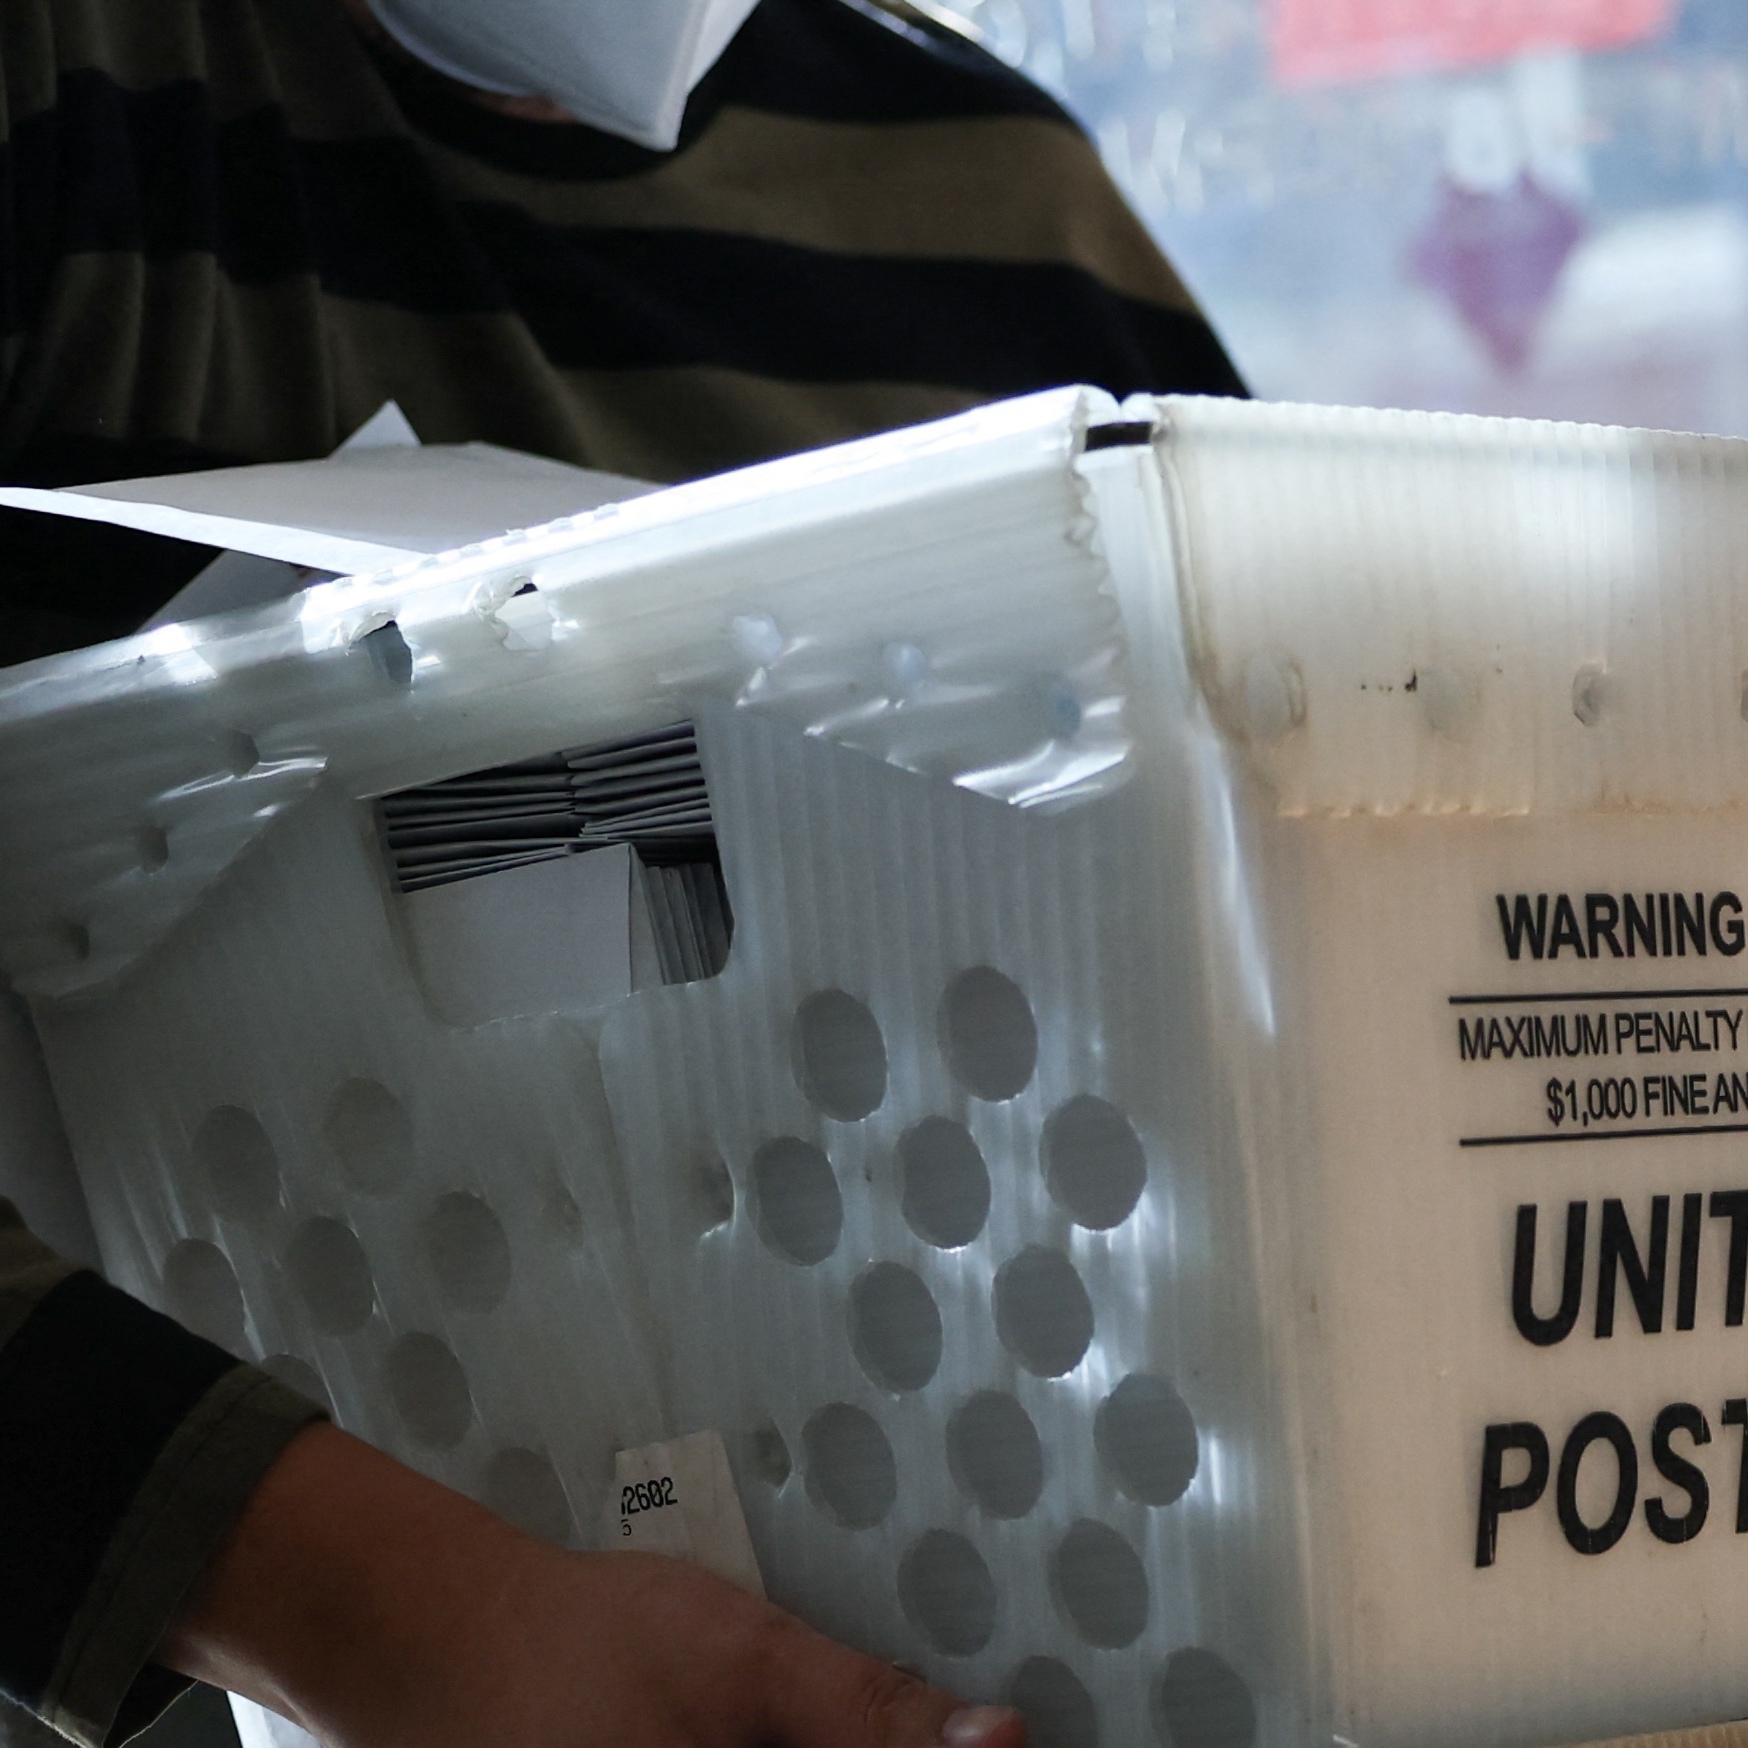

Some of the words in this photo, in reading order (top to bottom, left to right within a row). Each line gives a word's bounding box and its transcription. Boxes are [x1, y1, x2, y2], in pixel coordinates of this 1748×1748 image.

[1496, 891, 1746, 960] WARNING
[1459, 1013, 1608, 1060] MAXIMUM
[1615, 1008, 1743, 1054] PENALTY
[1546, 1076, 1638, 1126] $1,000
[1643, 1073, 1709, 1117] FINE
